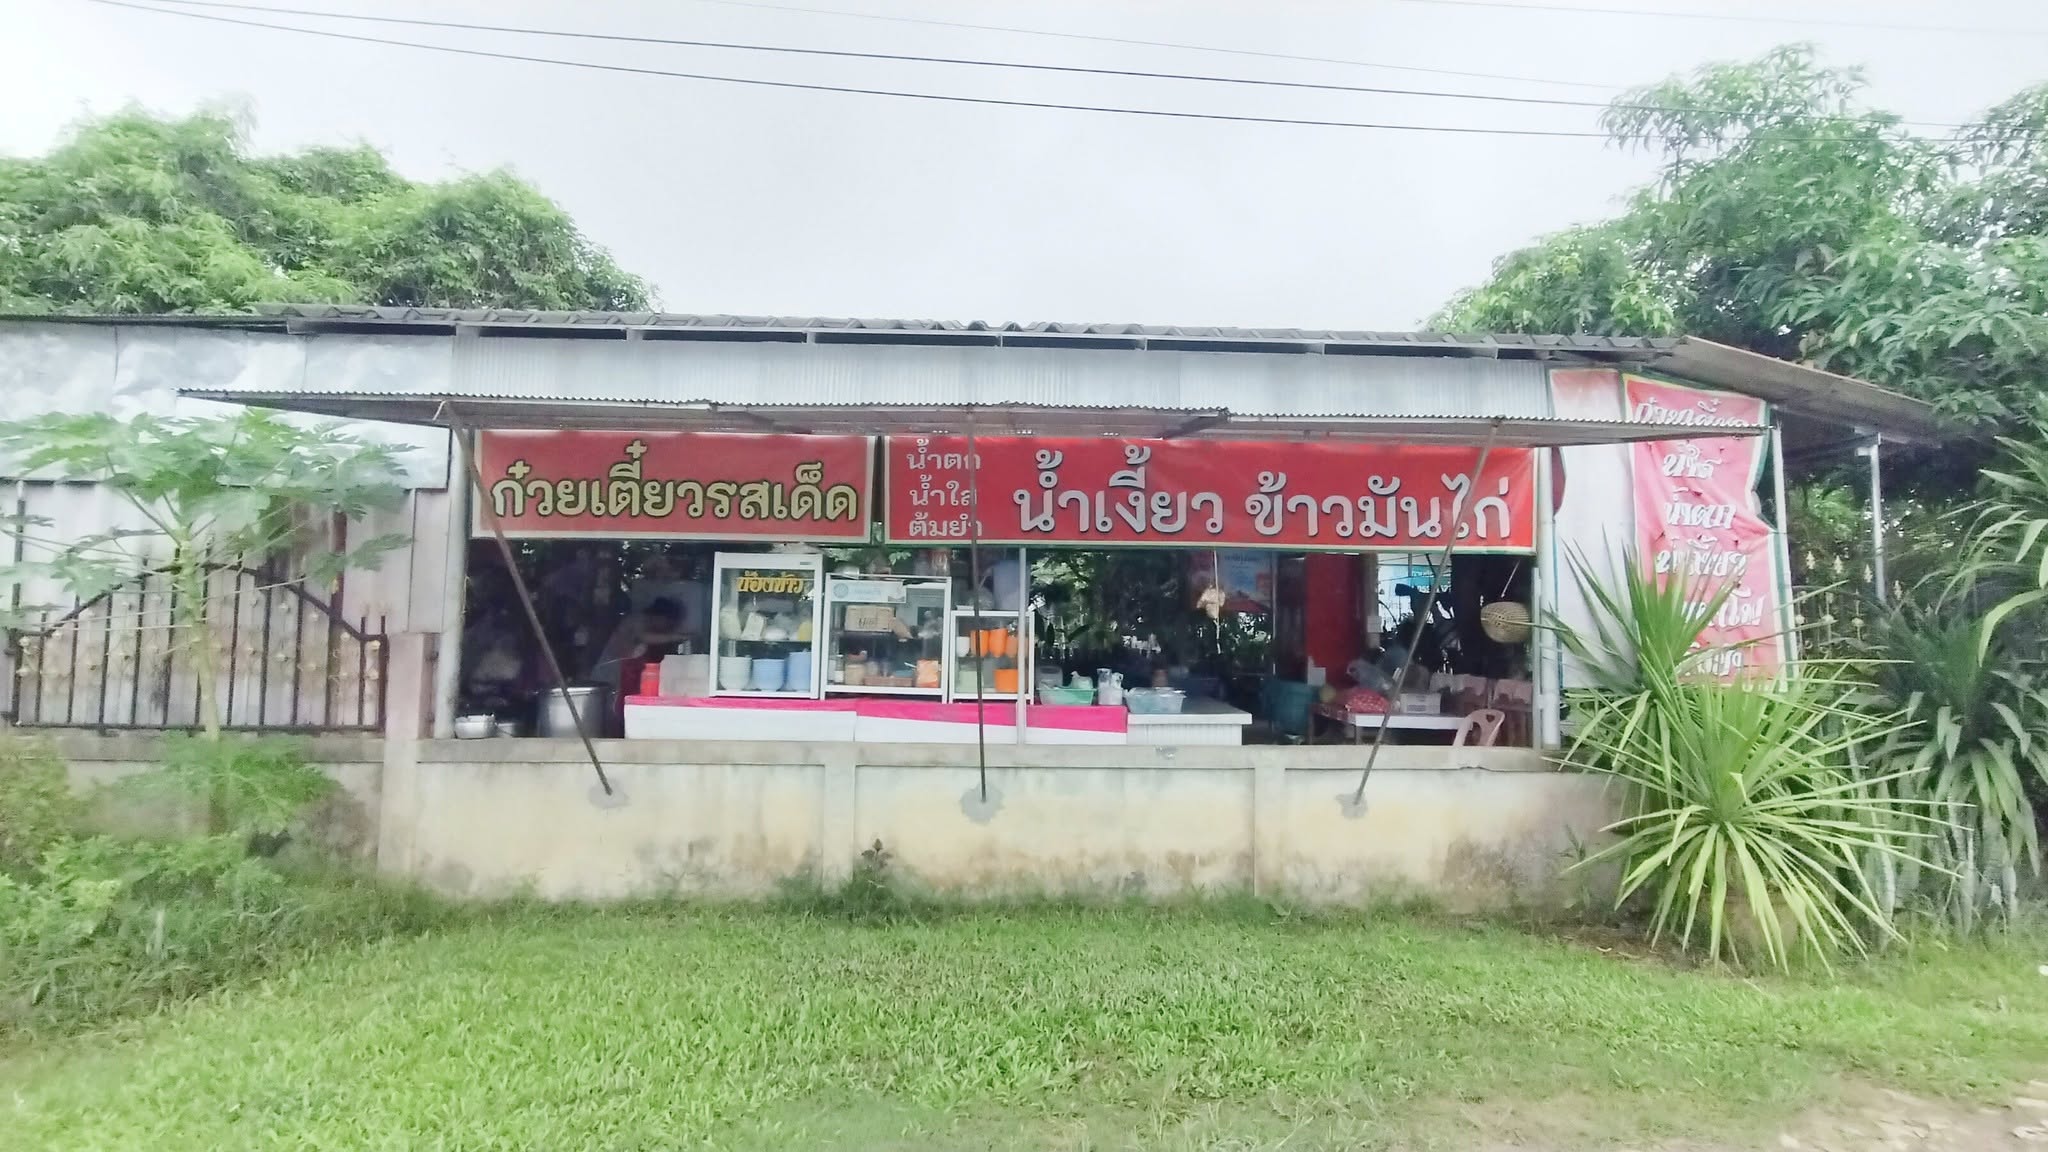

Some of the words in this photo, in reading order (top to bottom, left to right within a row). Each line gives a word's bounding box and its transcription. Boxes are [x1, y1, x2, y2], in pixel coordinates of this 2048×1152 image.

[490, 439, 859, 522] ก๋วยเตี๋ยวรสเด็ด
[906, 438, 981, 470] น้ำตก
[1012, 443, 1224, 535] น้ำเงี้ยว
[1245, 470, 1512, 539] ข้าวมันไก่
[908, 511, 983, 537] ต้มยำ
